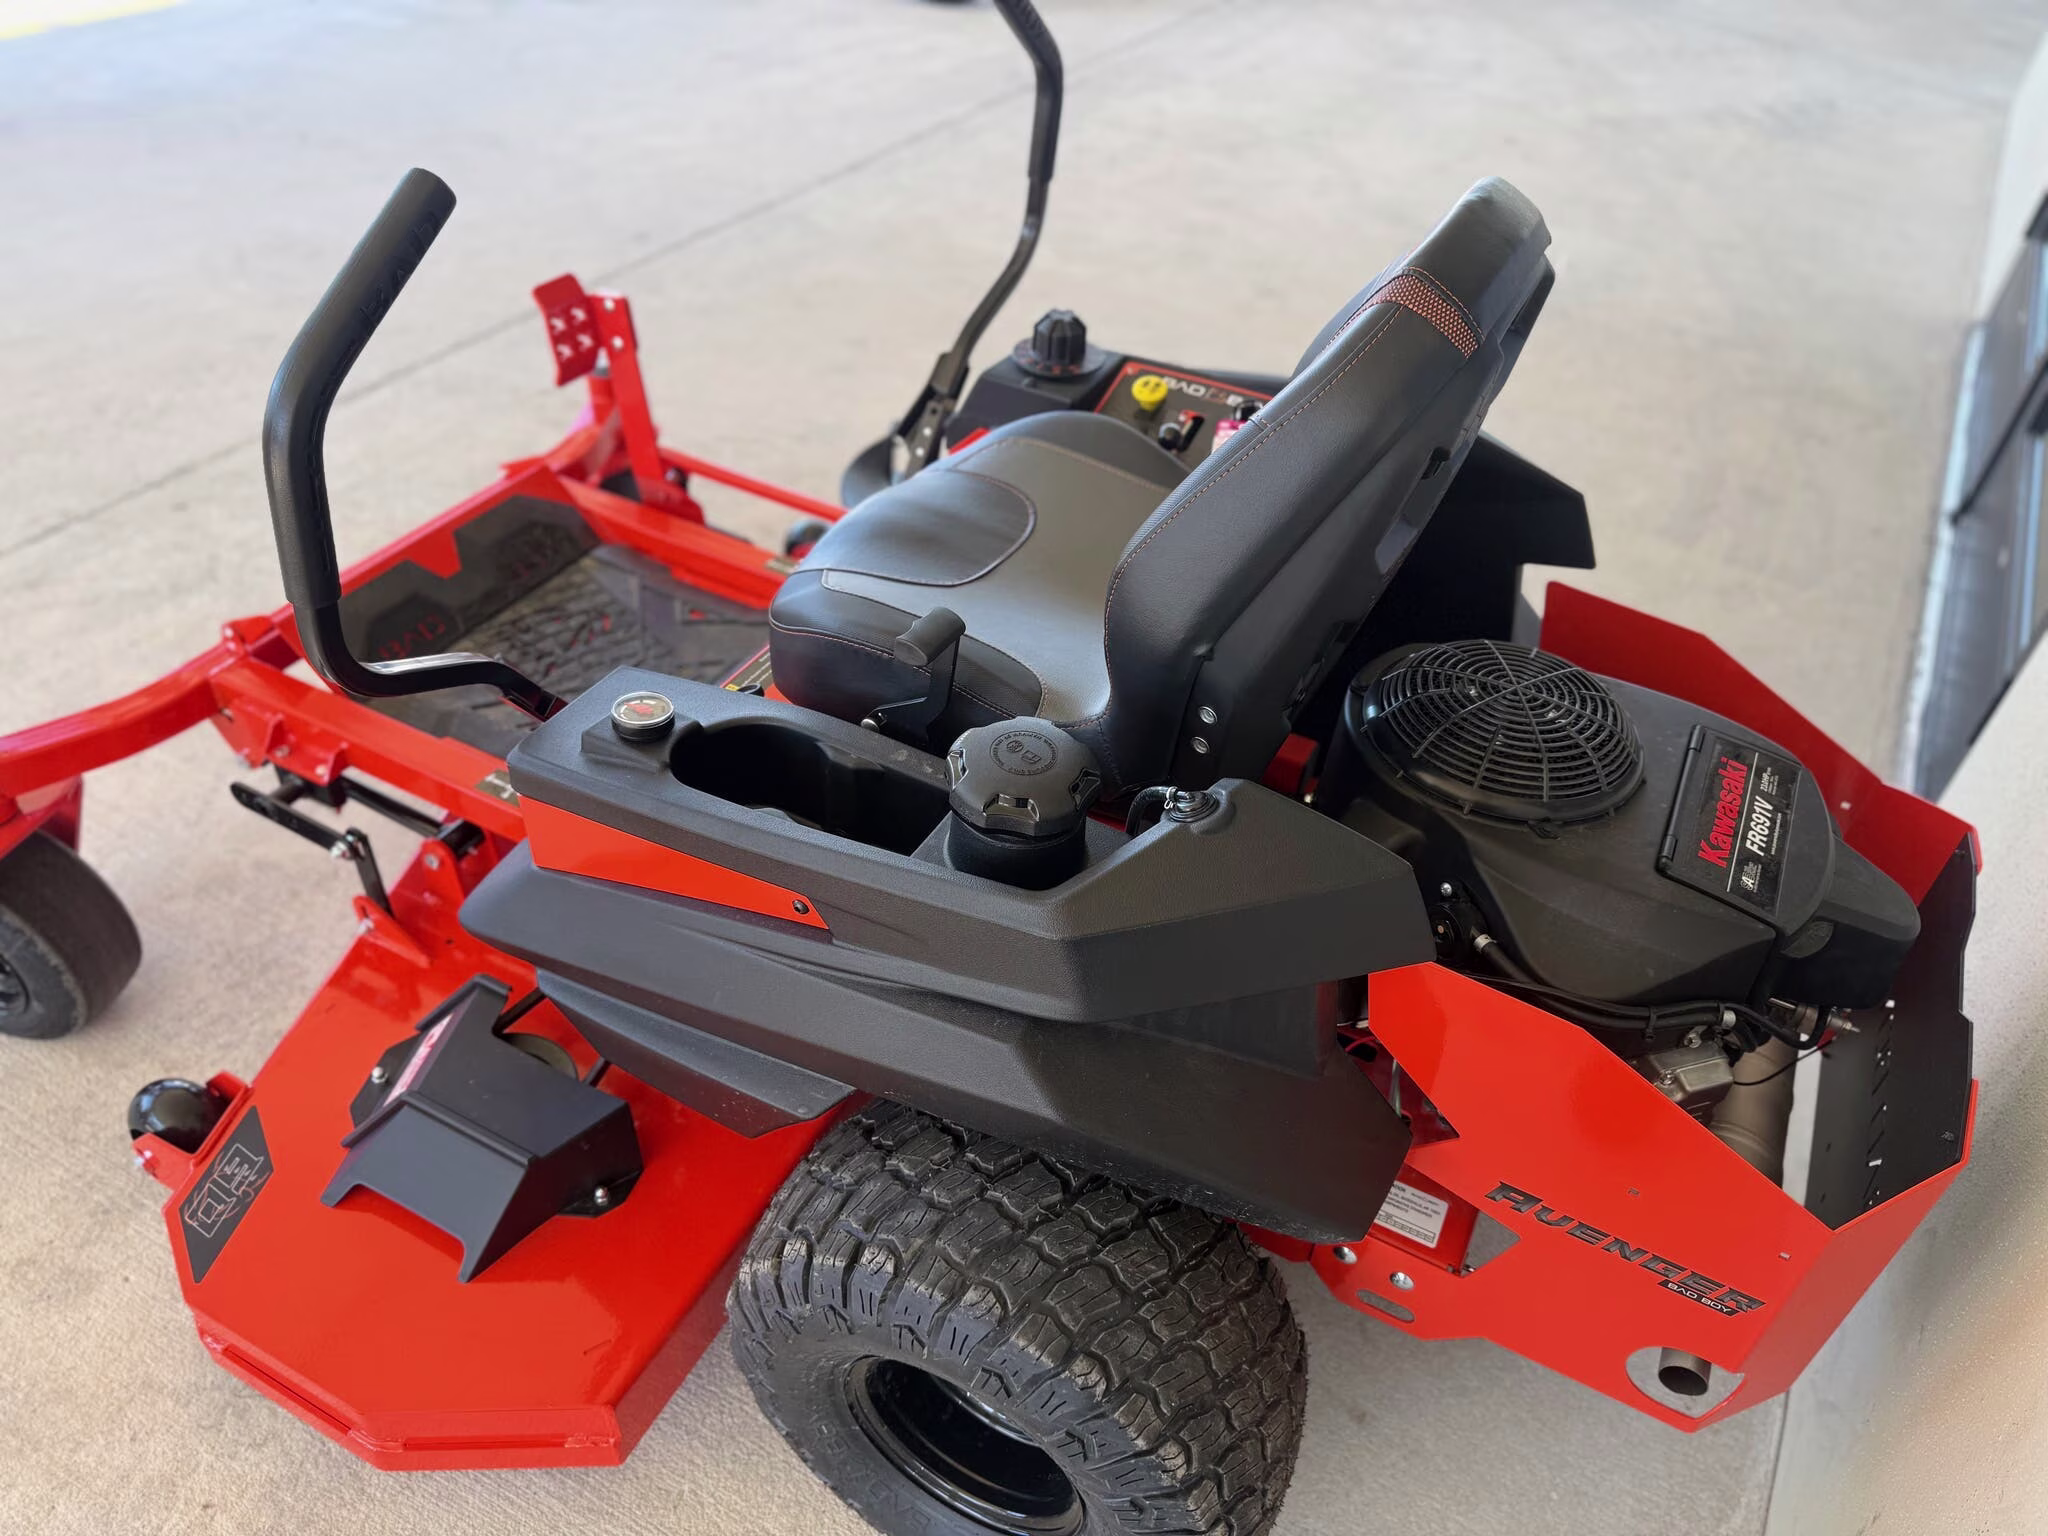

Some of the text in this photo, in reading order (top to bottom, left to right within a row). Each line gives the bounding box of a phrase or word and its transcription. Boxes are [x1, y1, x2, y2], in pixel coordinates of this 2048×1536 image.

[1698, 757, 1748, 868] Kawasaki
[1745, 795, 1775, 857] FR691V
[1485, 1181, 1766, 1312] AVENGER
[1667, 1281, 1732, 1313] BAD BOY
